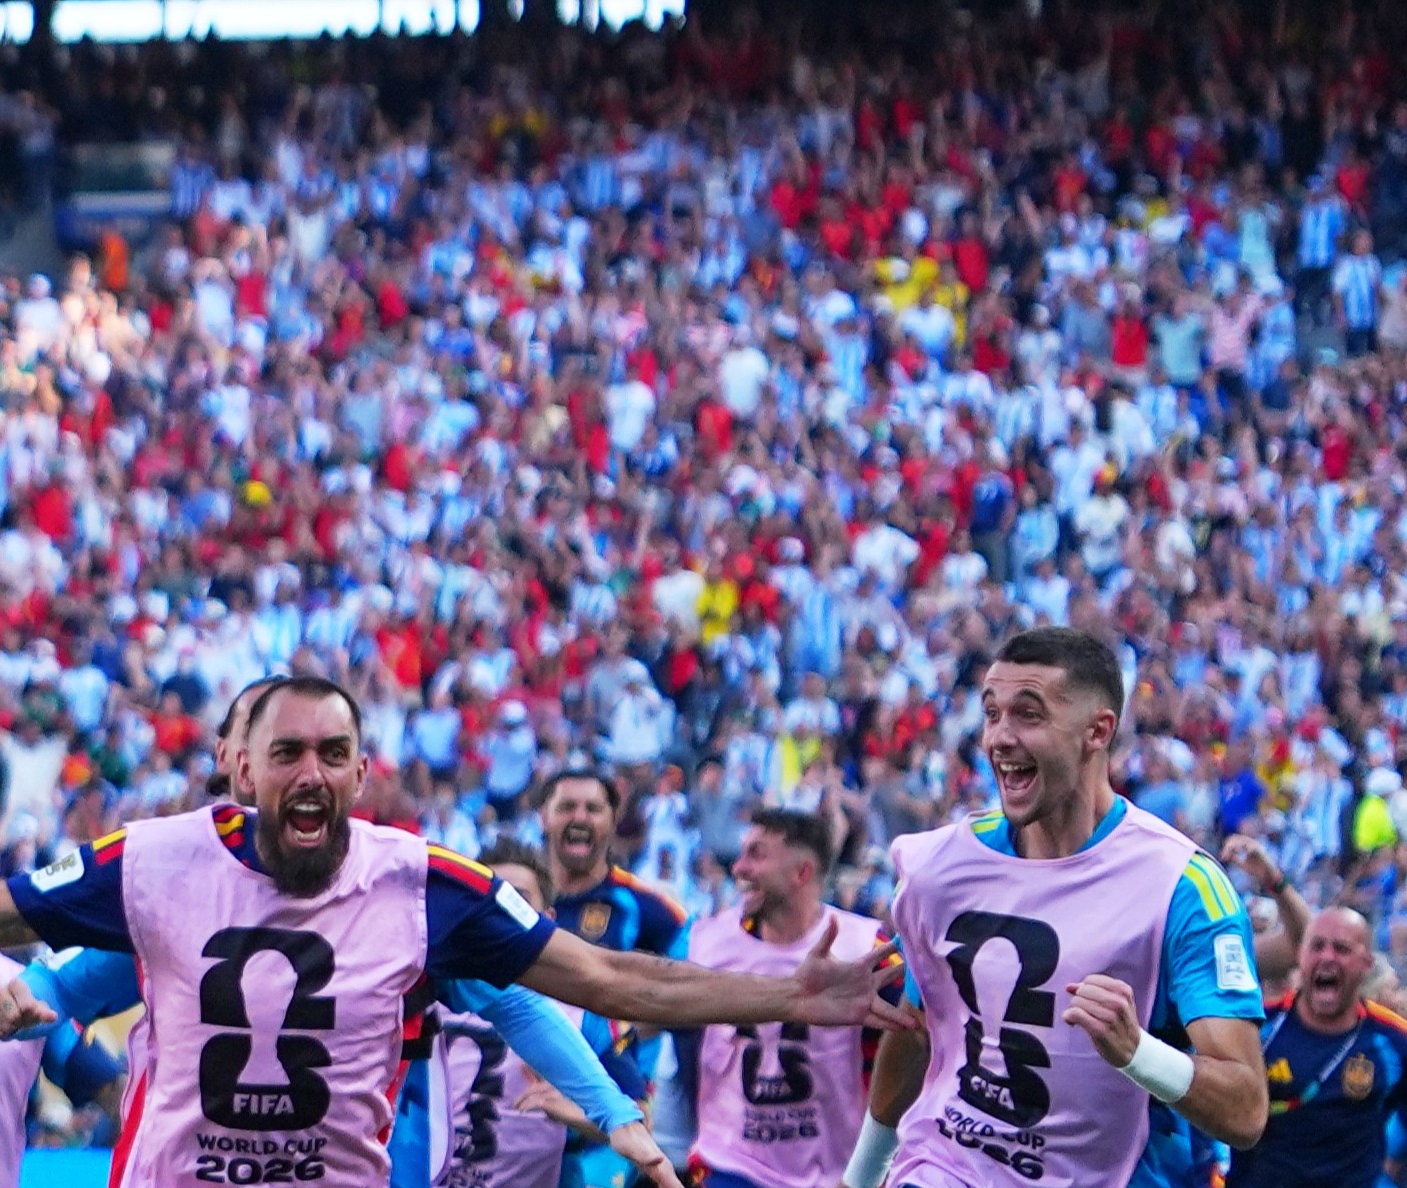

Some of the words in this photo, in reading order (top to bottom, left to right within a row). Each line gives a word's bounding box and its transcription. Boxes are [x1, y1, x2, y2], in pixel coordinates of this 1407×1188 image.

[233, 1093, 295, 1116] FIFA
[970, 1075, 1015, 1110] FIFA
[196, 1133, 279, 1155] WORLD
[285, 1137, 328, 1156] CUP
[195, 1154, 325, 1185] 2026
